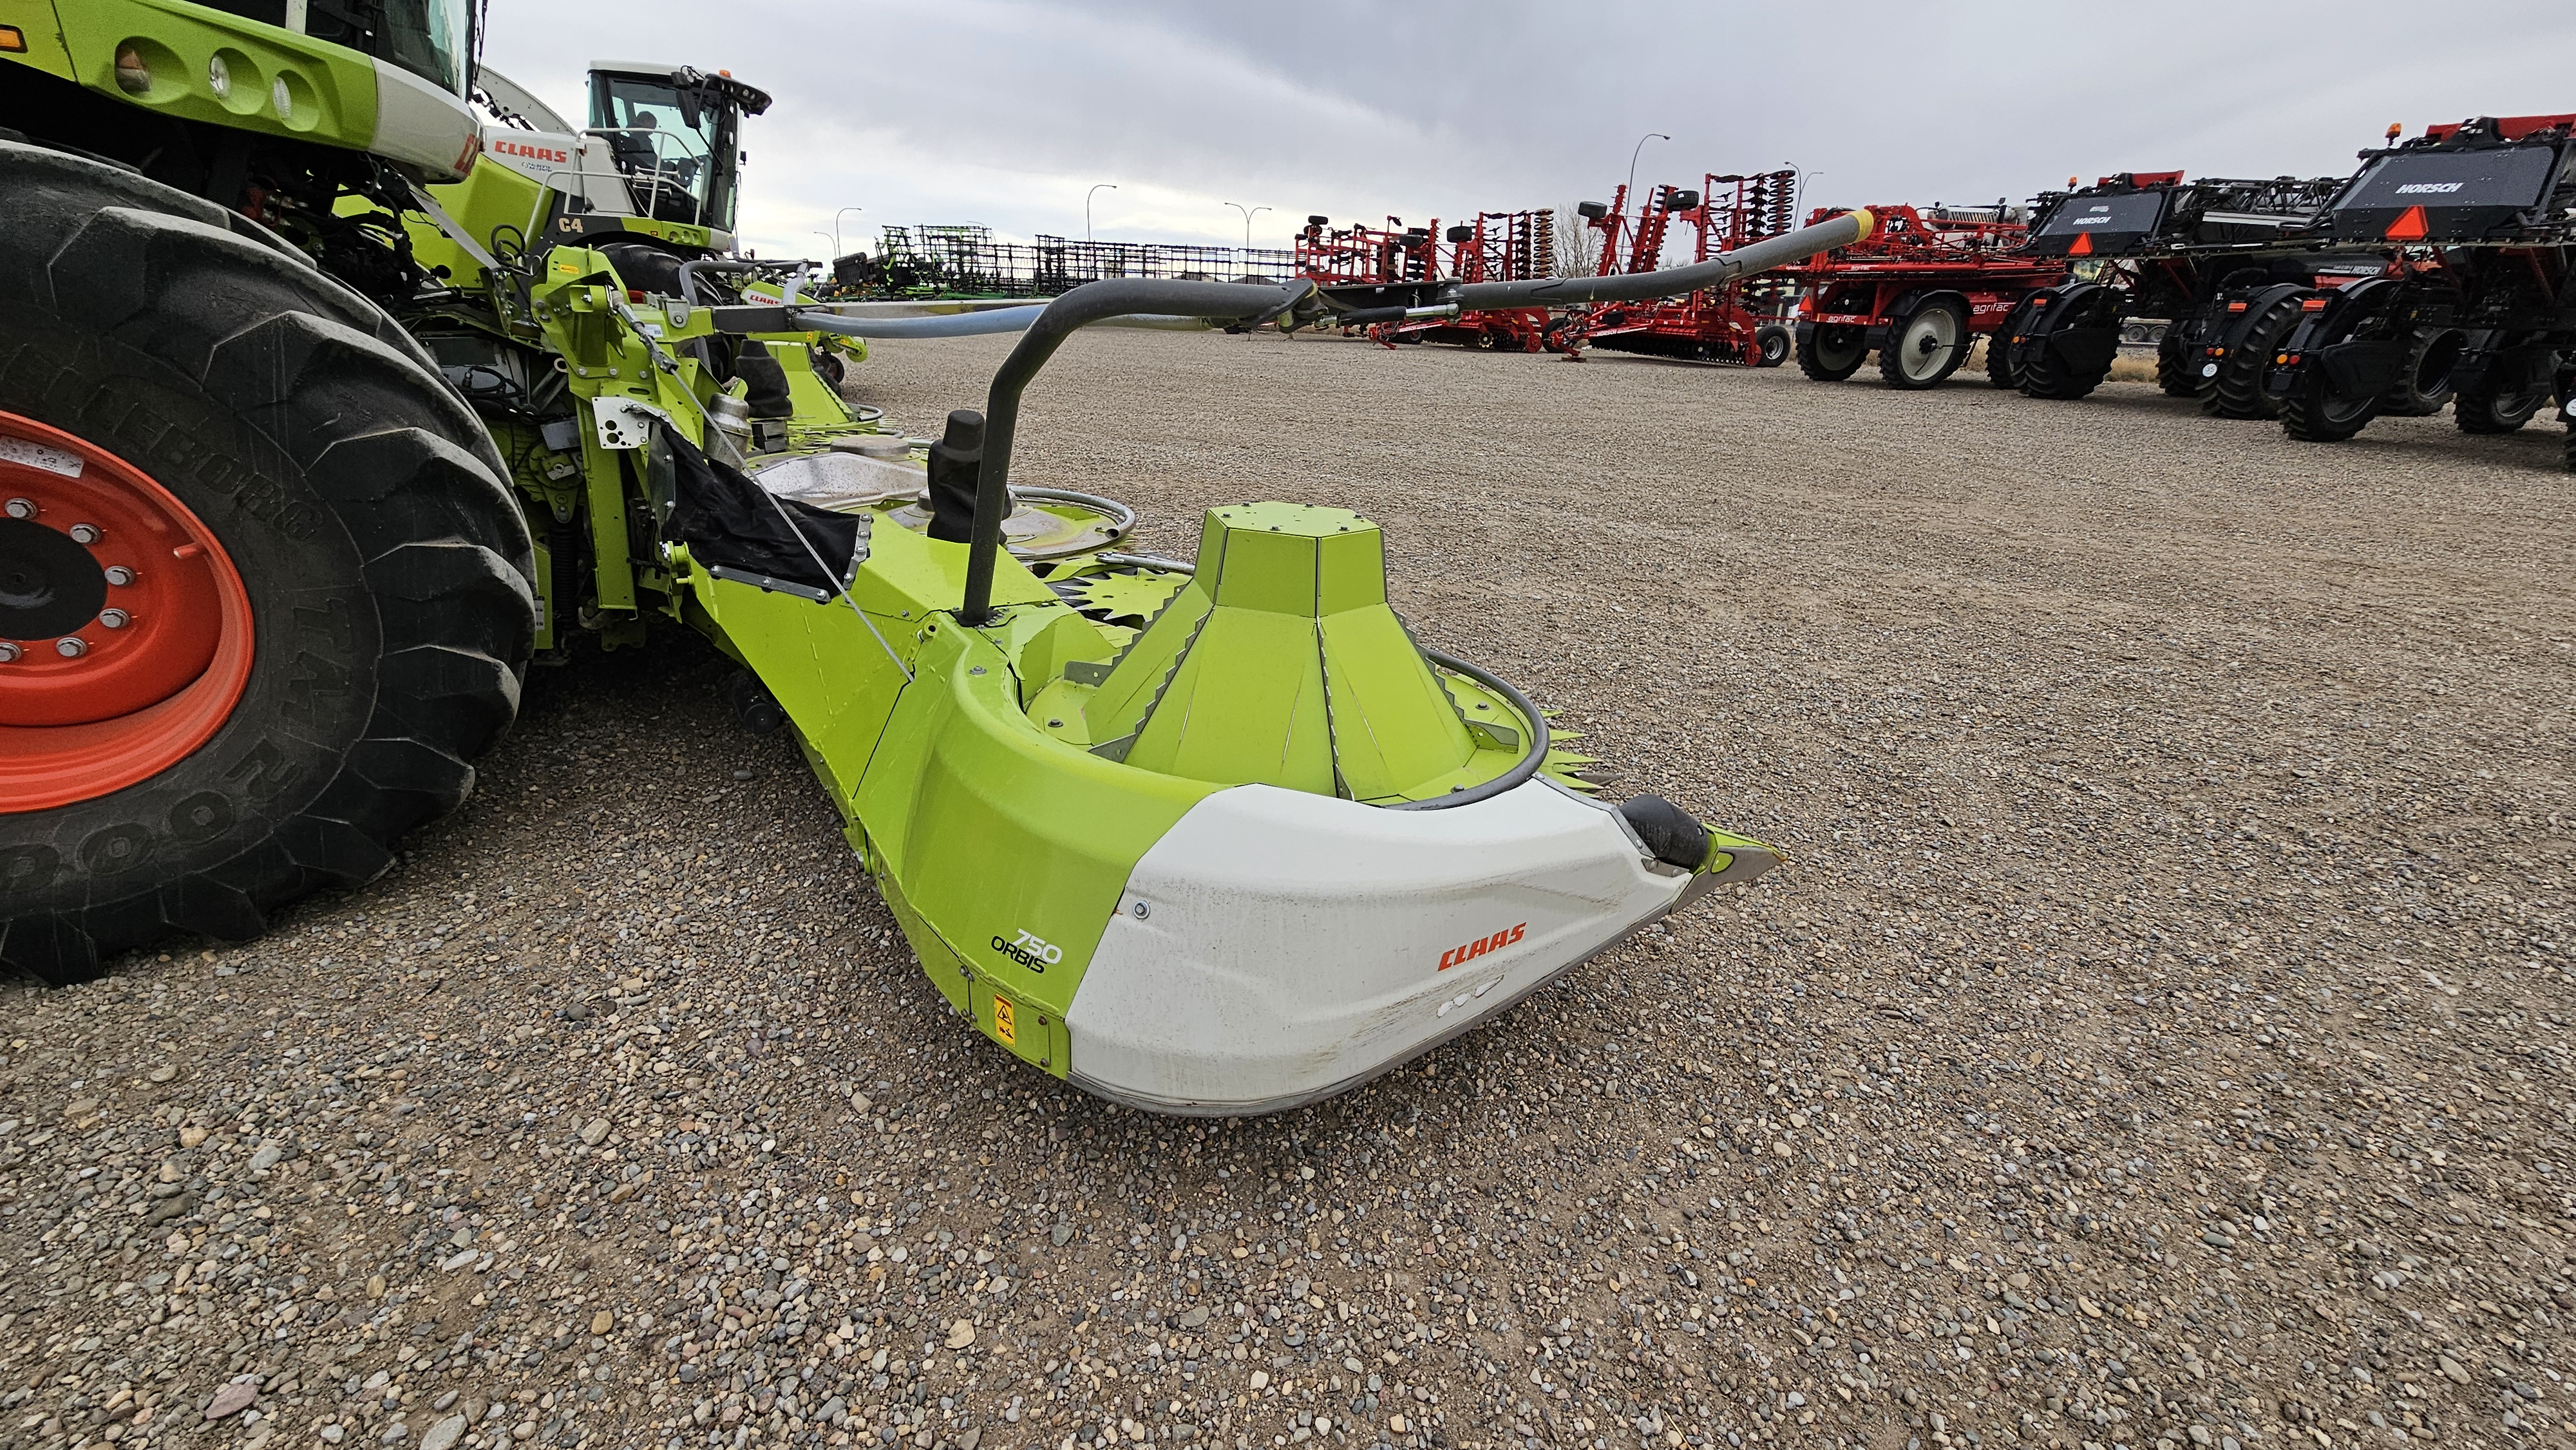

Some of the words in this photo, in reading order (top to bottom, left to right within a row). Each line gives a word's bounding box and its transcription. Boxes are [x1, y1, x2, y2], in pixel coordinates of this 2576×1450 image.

[495, 140, 567, 163] CLAAS
[2396, 183, 2464, 194] HORSCH
[558, 218, 583, 233] C4
[2073, 216, 2112, 225] HORSCH
[2351, 265, 2382, 276] HORSCH
[1973, 302, 2015, 314] agrifac
[1012, 928, 1063, 965] 750
[1438, 921, 1527, 972] CLAAS
[991, 936, 1048, 974] ORBIS
